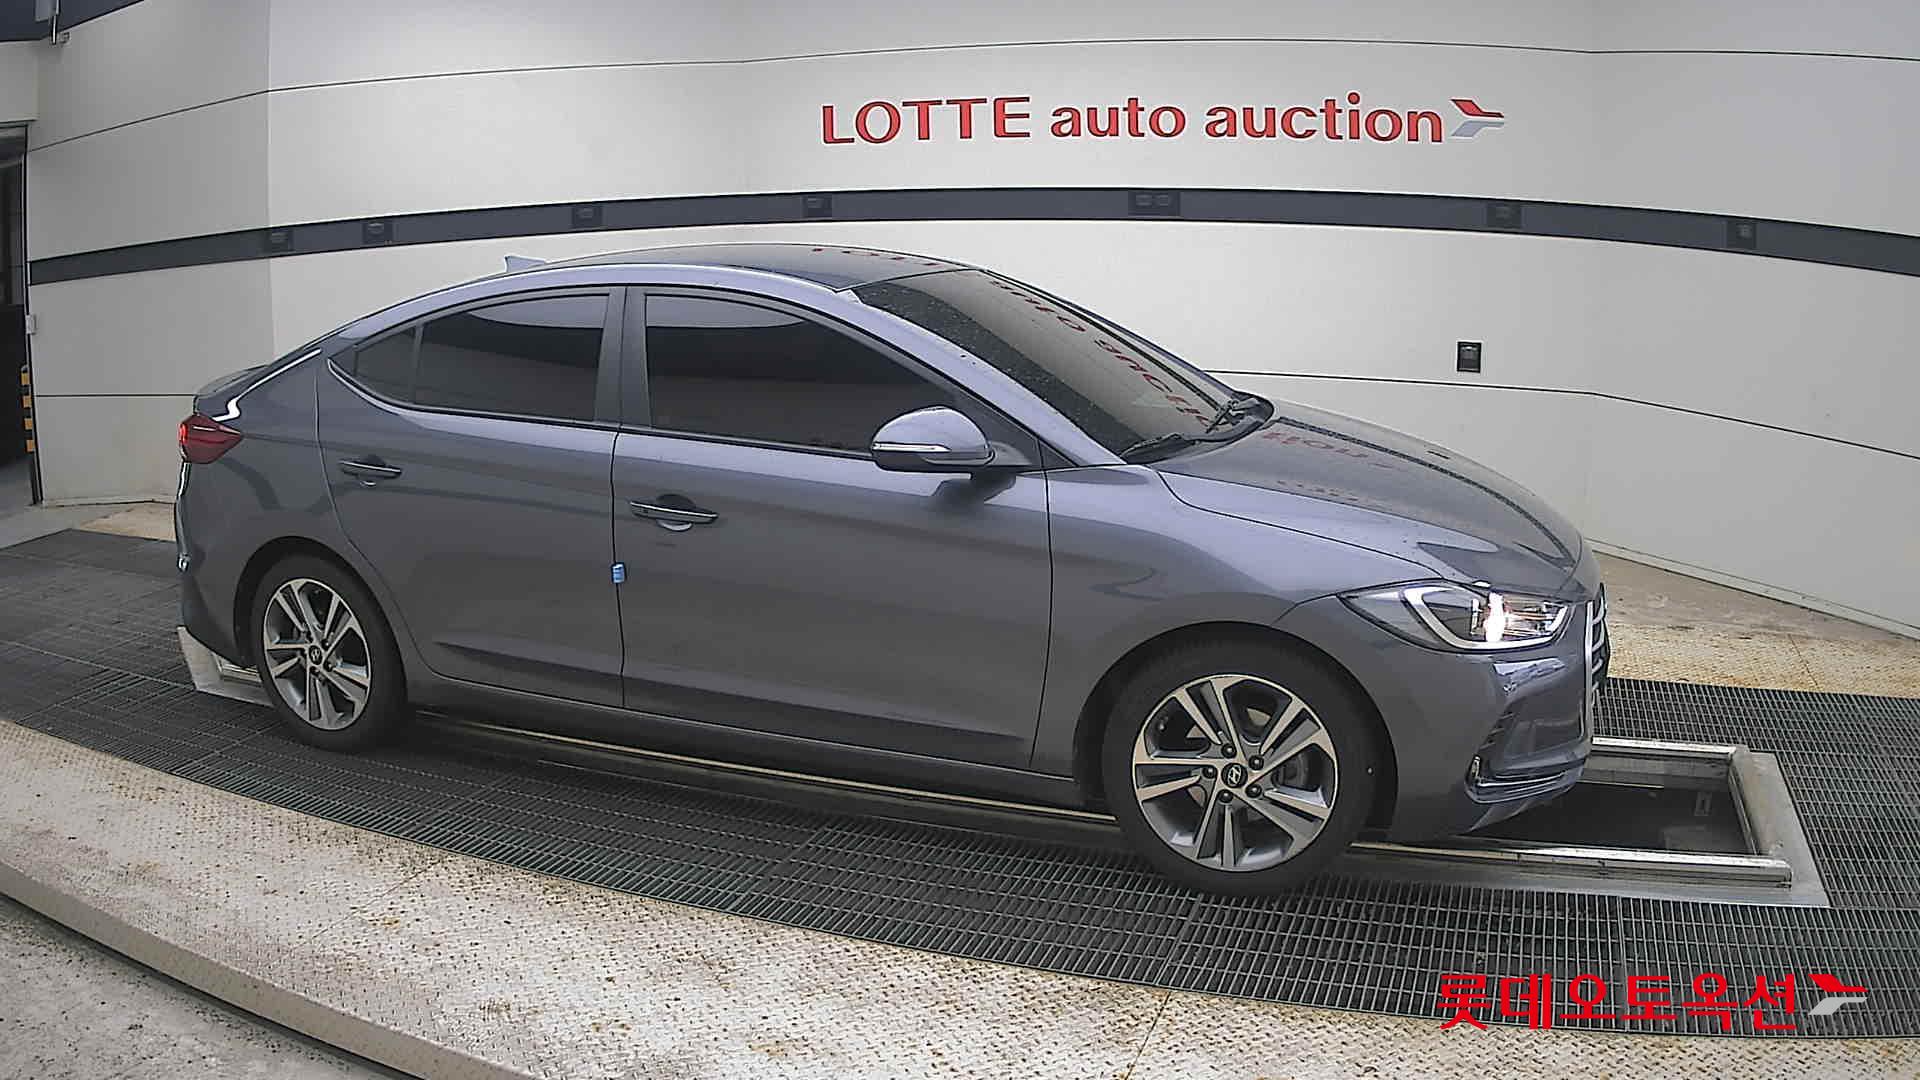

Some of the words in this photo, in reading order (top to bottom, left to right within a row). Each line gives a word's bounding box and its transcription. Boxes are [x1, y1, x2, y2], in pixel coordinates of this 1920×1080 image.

[822, 95, 1030, 144] LOTTE
[1049, 97, 1187, 139] auto
[1205, 91, 1444, 143] auction
